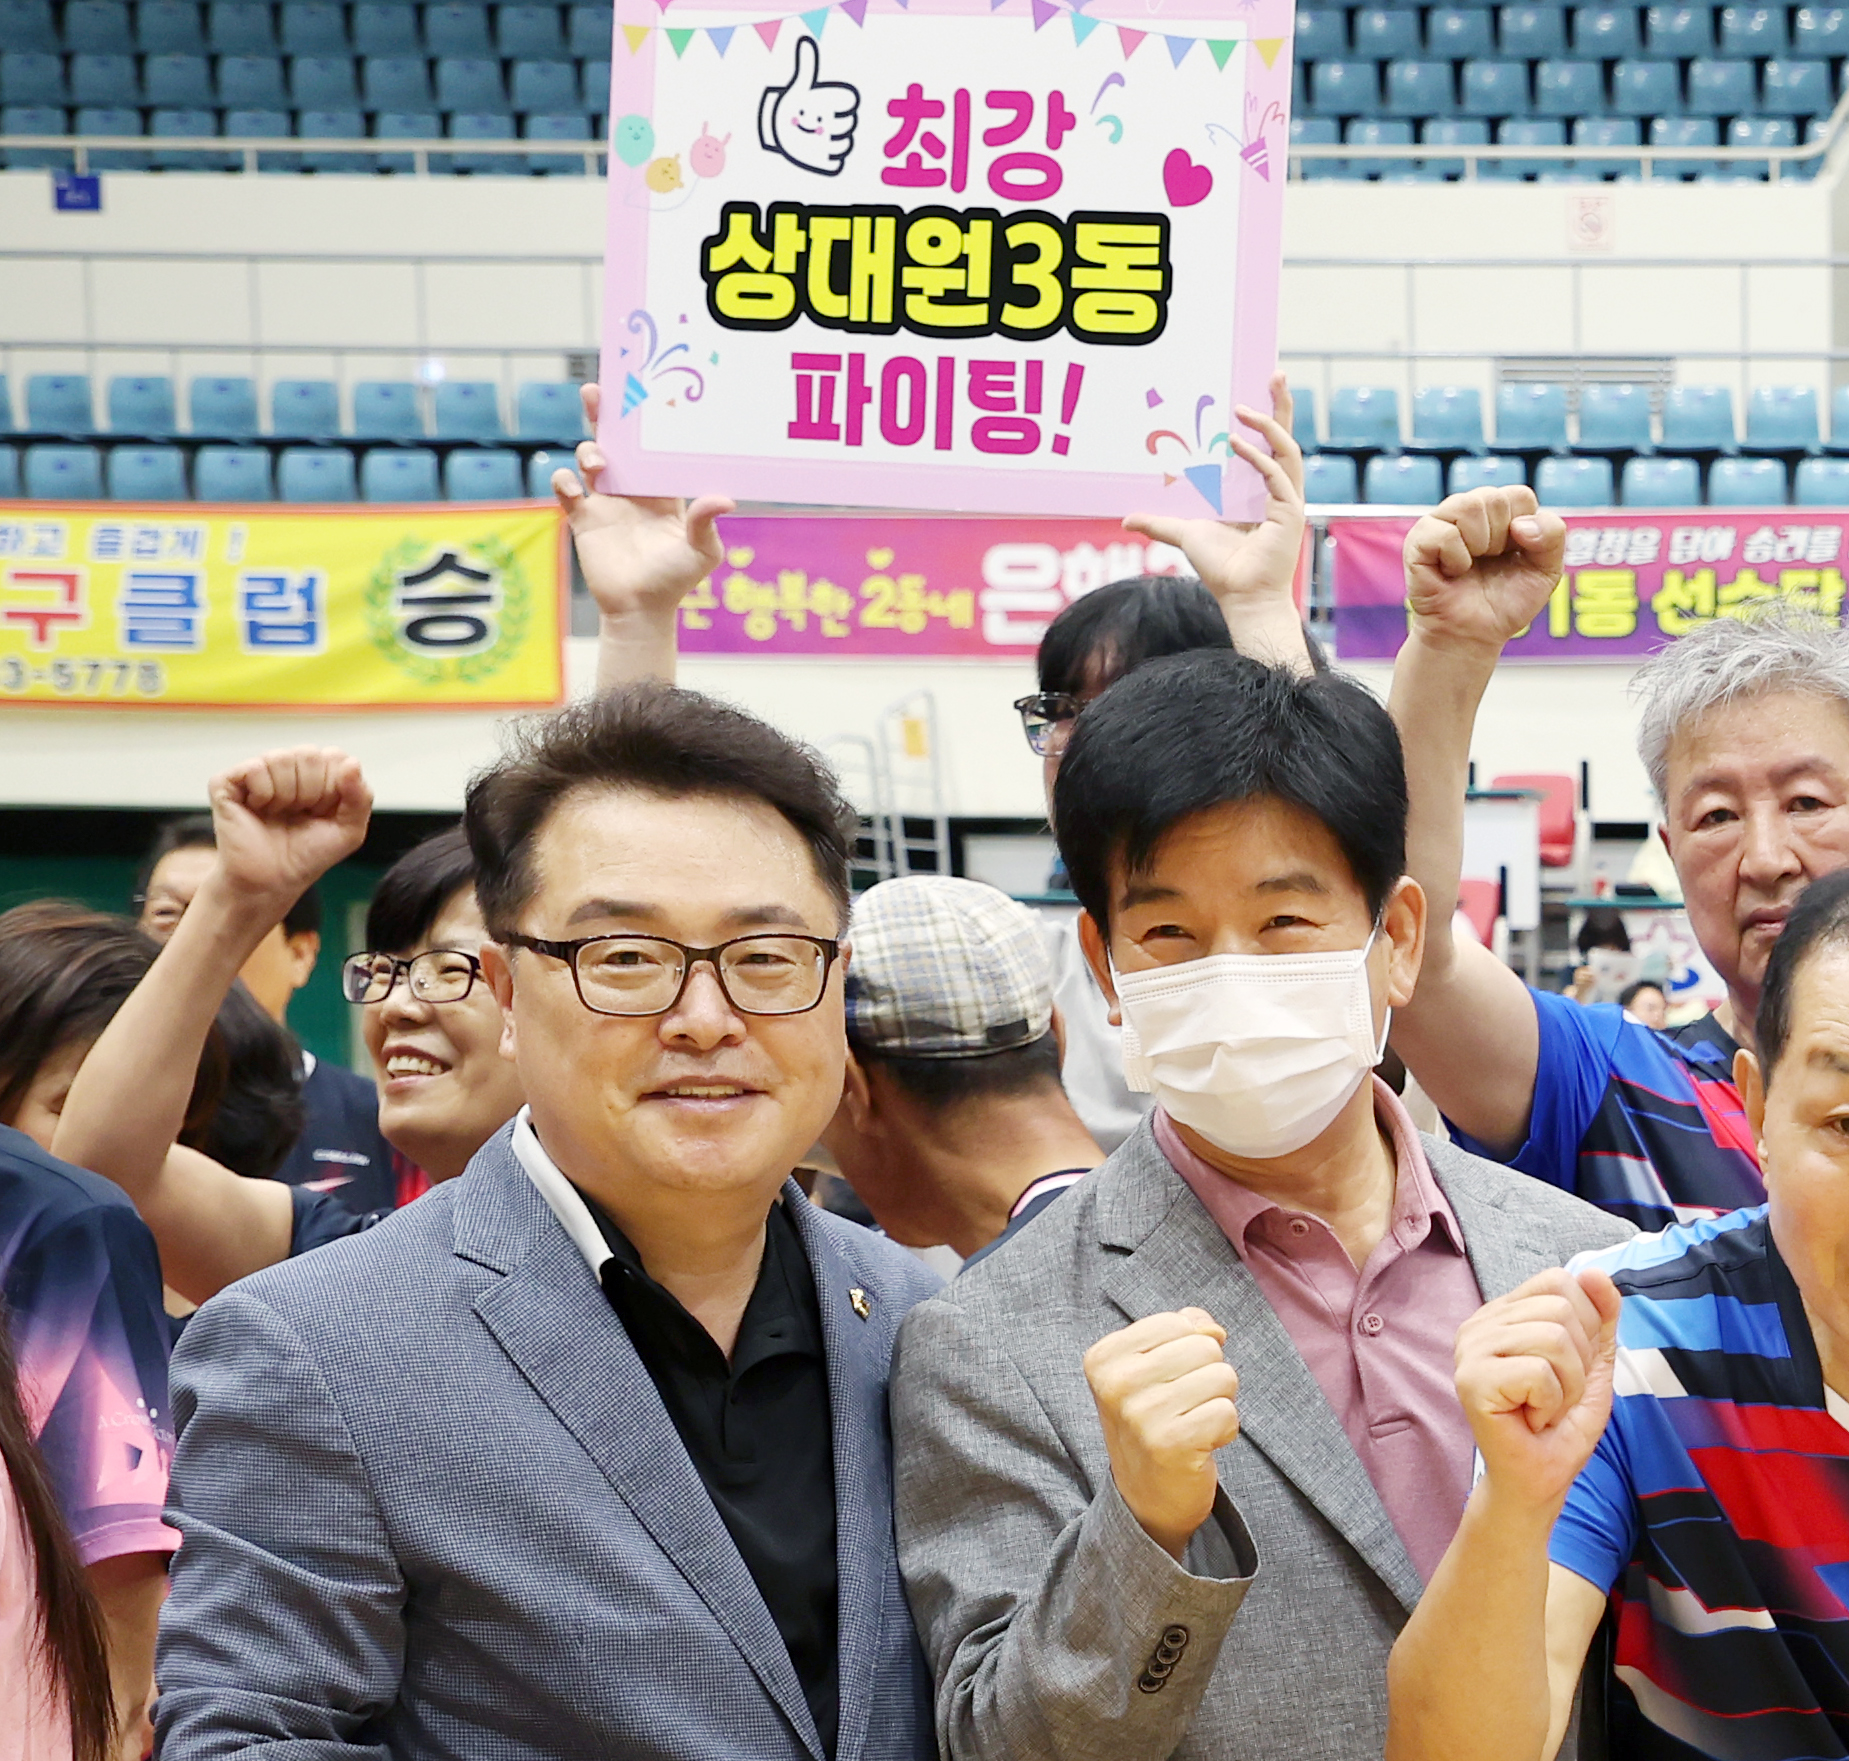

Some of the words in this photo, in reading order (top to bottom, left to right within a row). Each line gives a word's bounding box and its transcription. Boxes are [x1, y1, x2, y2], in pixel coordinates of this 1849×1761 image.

[881, 84, 1076, 201] 최강
[704, 207, 1168, 340] 상대원3동
[788, 353, 1085, 455] 파이팅!
[1565, 526, 1662, 566] 열정을
[1669, 525, 1738, 564] 담아
[1743, 525, 1844, 564] 승리를
[402, 552, 492, 647] 승
[722, 571, 857, 641] 행복한
[858, 572, 976, 635] 2동네
